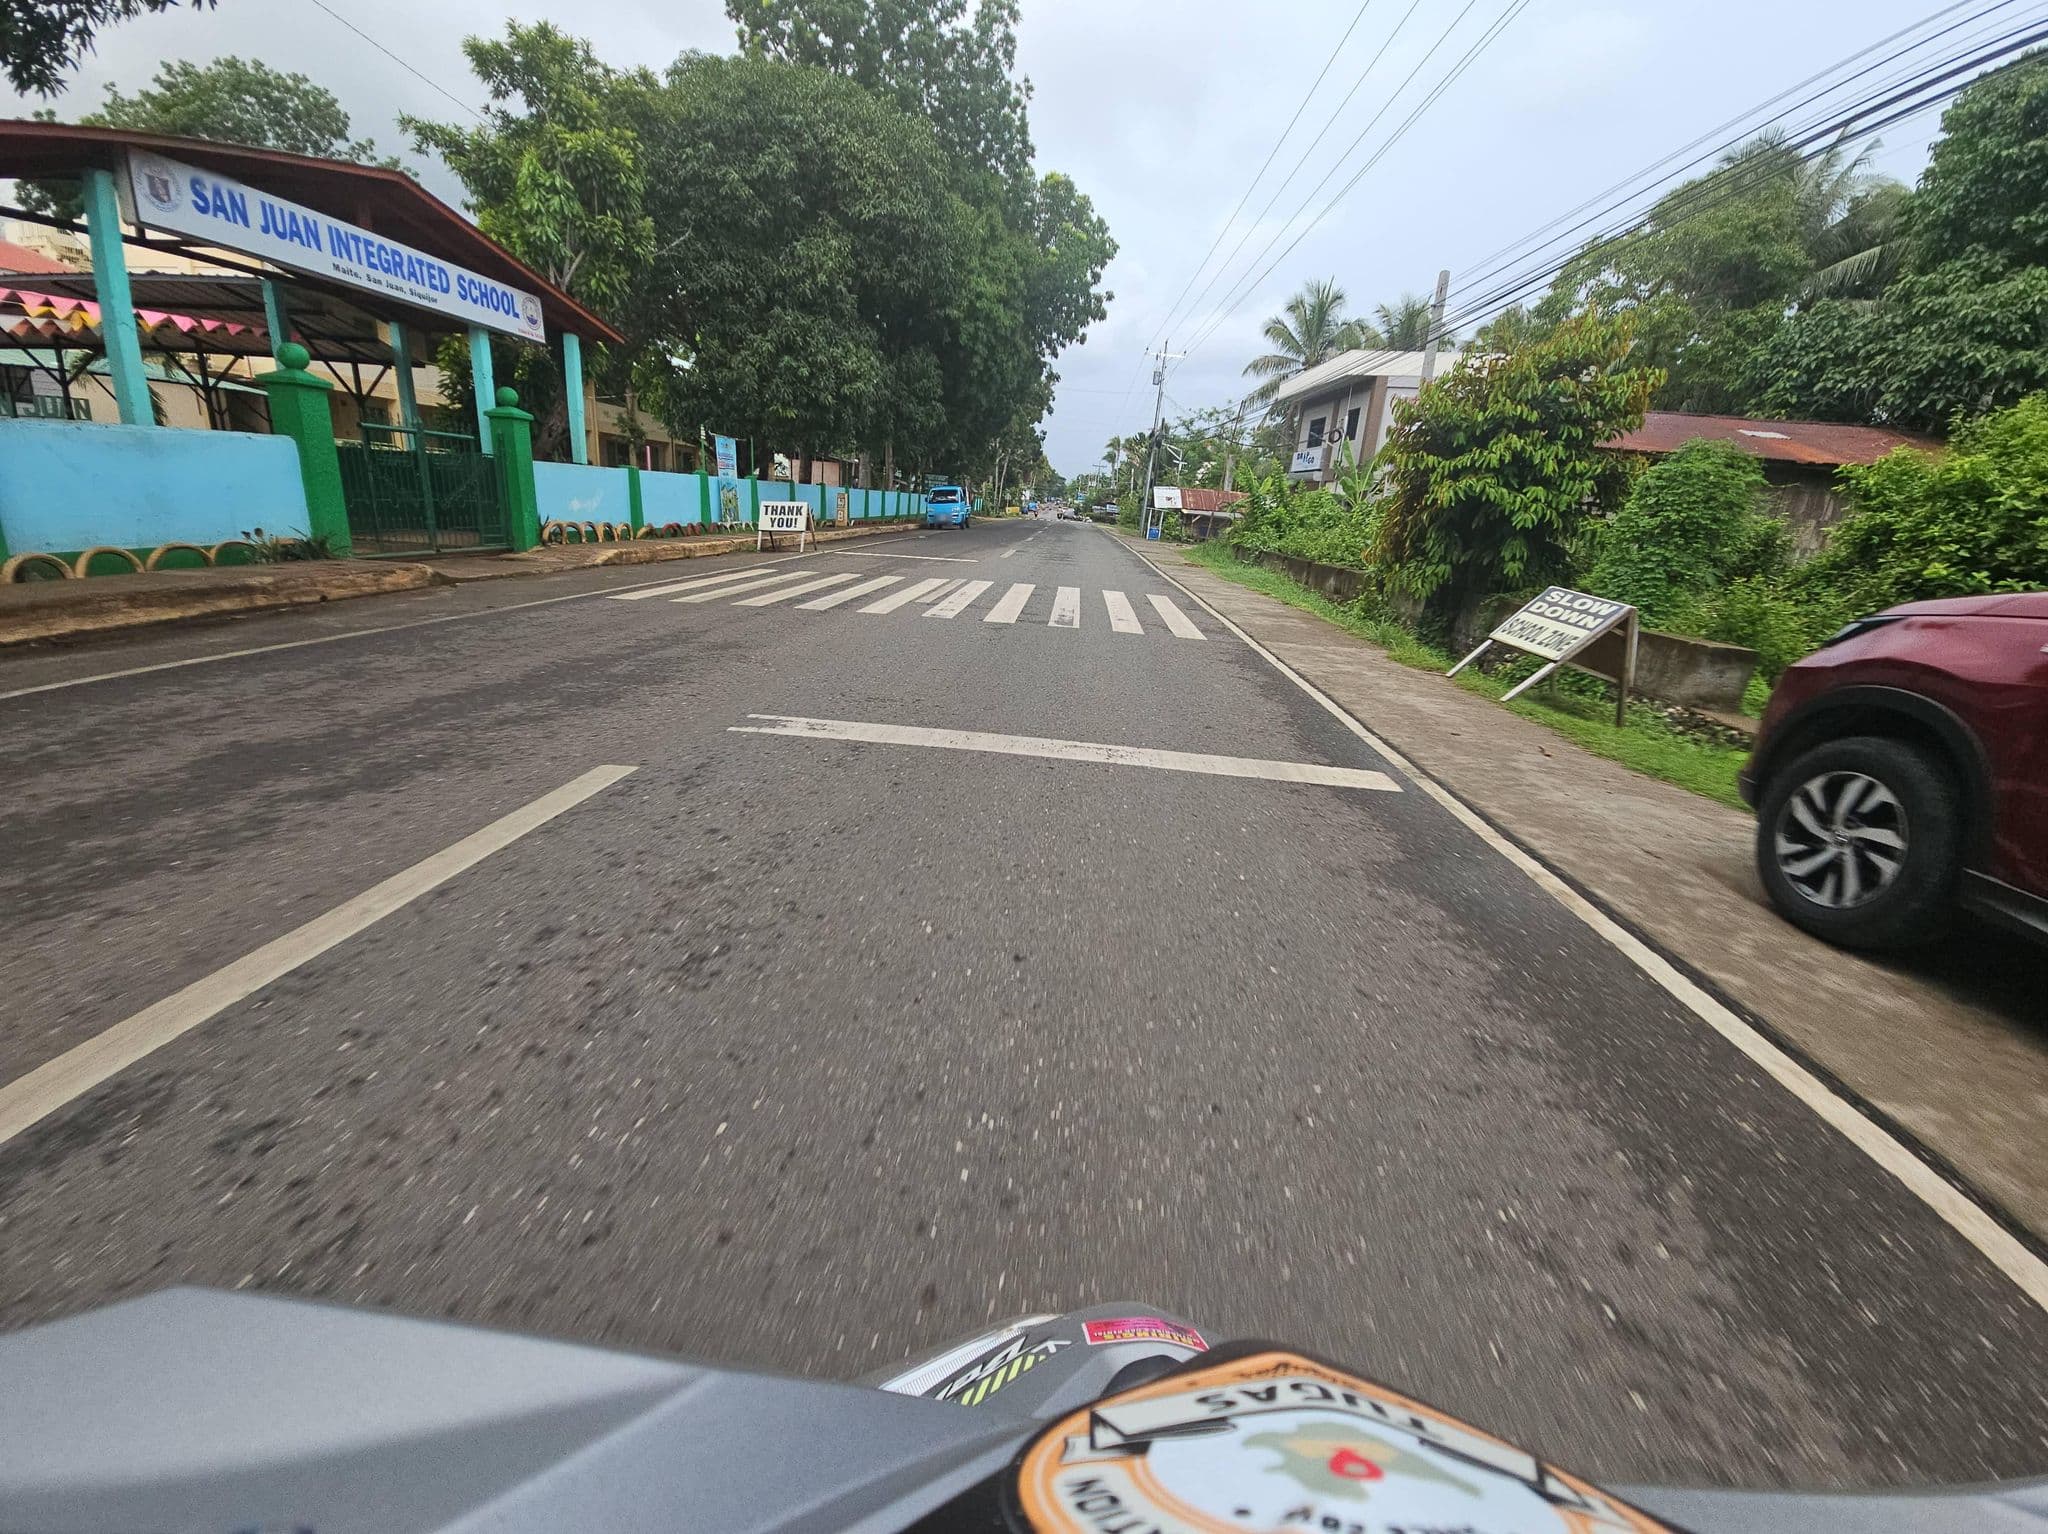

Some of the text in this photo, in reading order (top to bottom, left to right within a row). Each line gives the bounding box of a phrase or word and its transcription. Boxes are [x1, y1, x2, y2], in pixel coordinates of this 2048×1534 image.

[190, 175, 250, 228] SAN
[260, 200, 322, 252] JUAN
[327, 224, 451, 295] INTEGRATED
[456, 273, 520, 319] SCHOOL
[366, 273, 383, 286] San
[763, 504, 803, 516] THANK
[770, 517, 798, 528] YOU!
[1527, 601, 1604, 629] DOWN
[1545, 590, 1620, 616] SLOW
[1500, 617, 1550, 645] SCHOOL
[1541, 629, 1581, 652] ZONE
